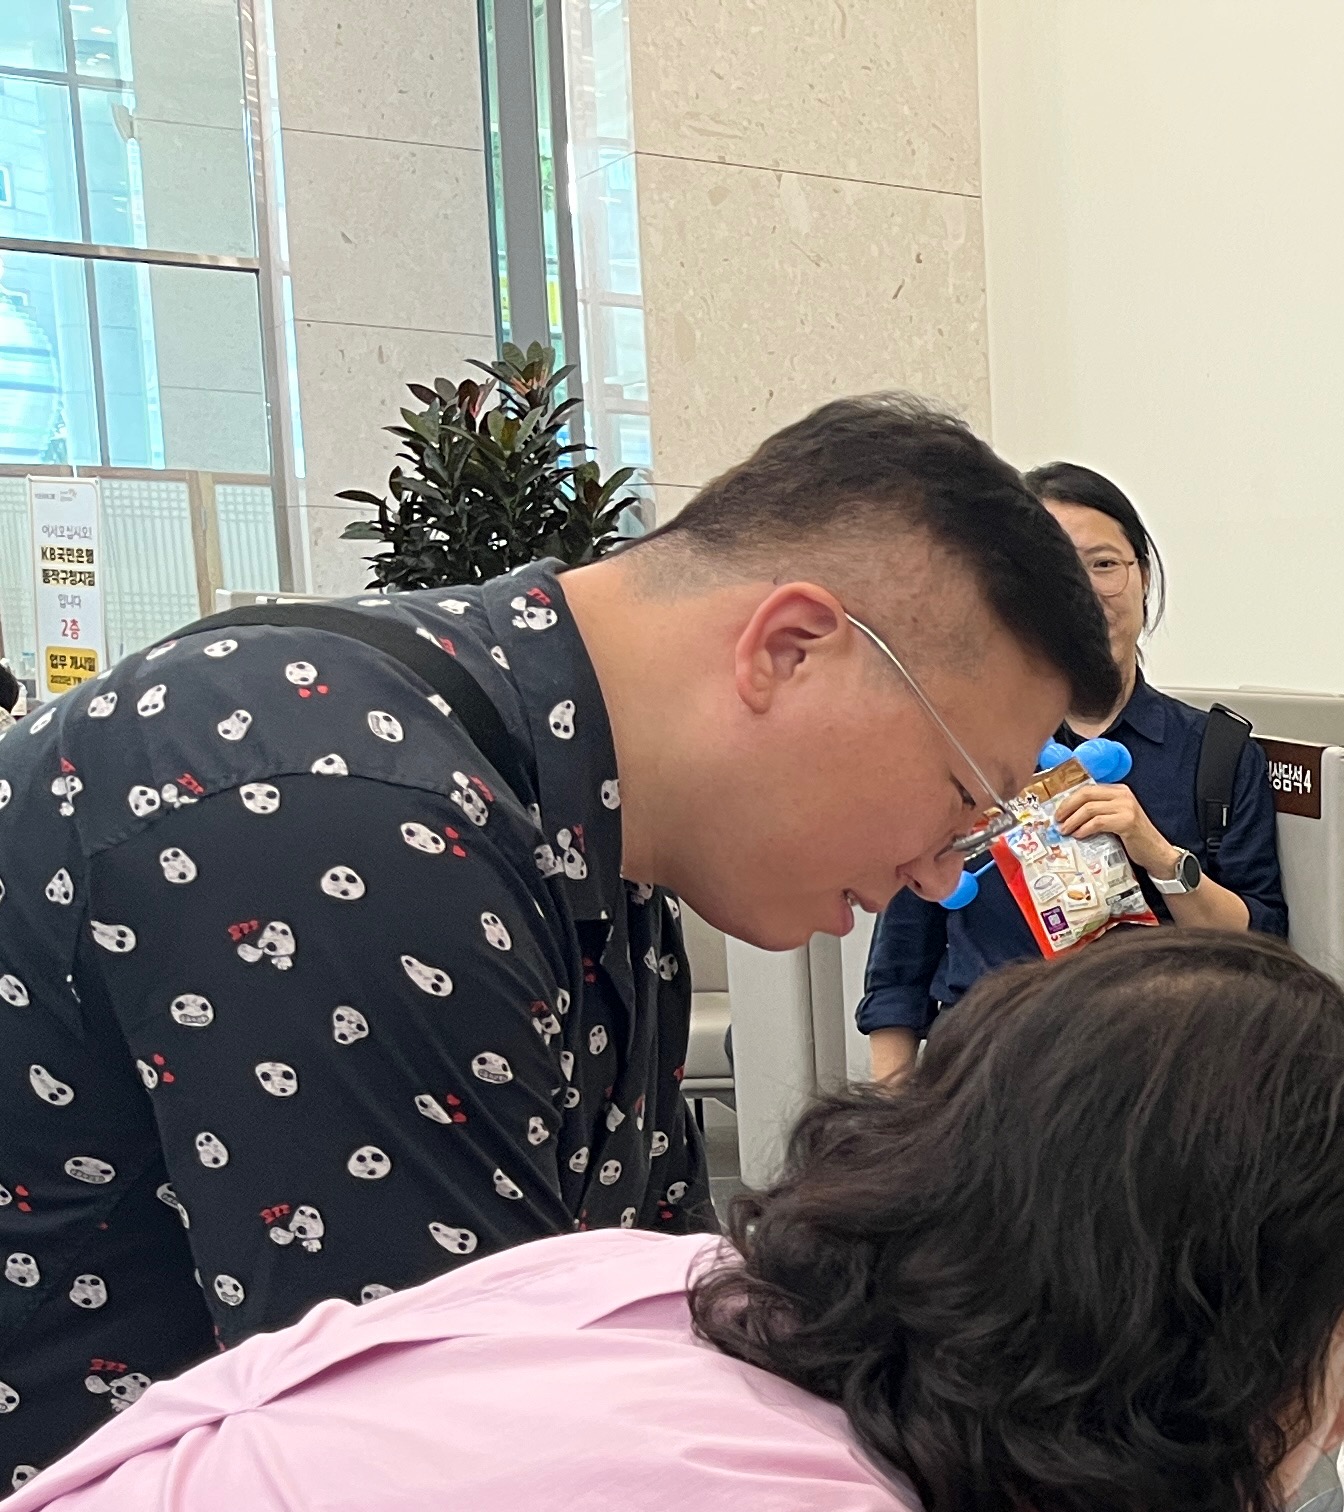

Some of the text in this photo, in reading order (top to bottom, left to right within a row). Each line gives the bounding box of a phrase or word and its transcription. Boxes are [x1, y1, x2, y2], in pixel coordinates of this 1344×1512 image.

[40, 546, 94, 564] KB국민은행
[60, 618, 80, 640] 2층
[1268, 760, 1312, 795] 상담석4
